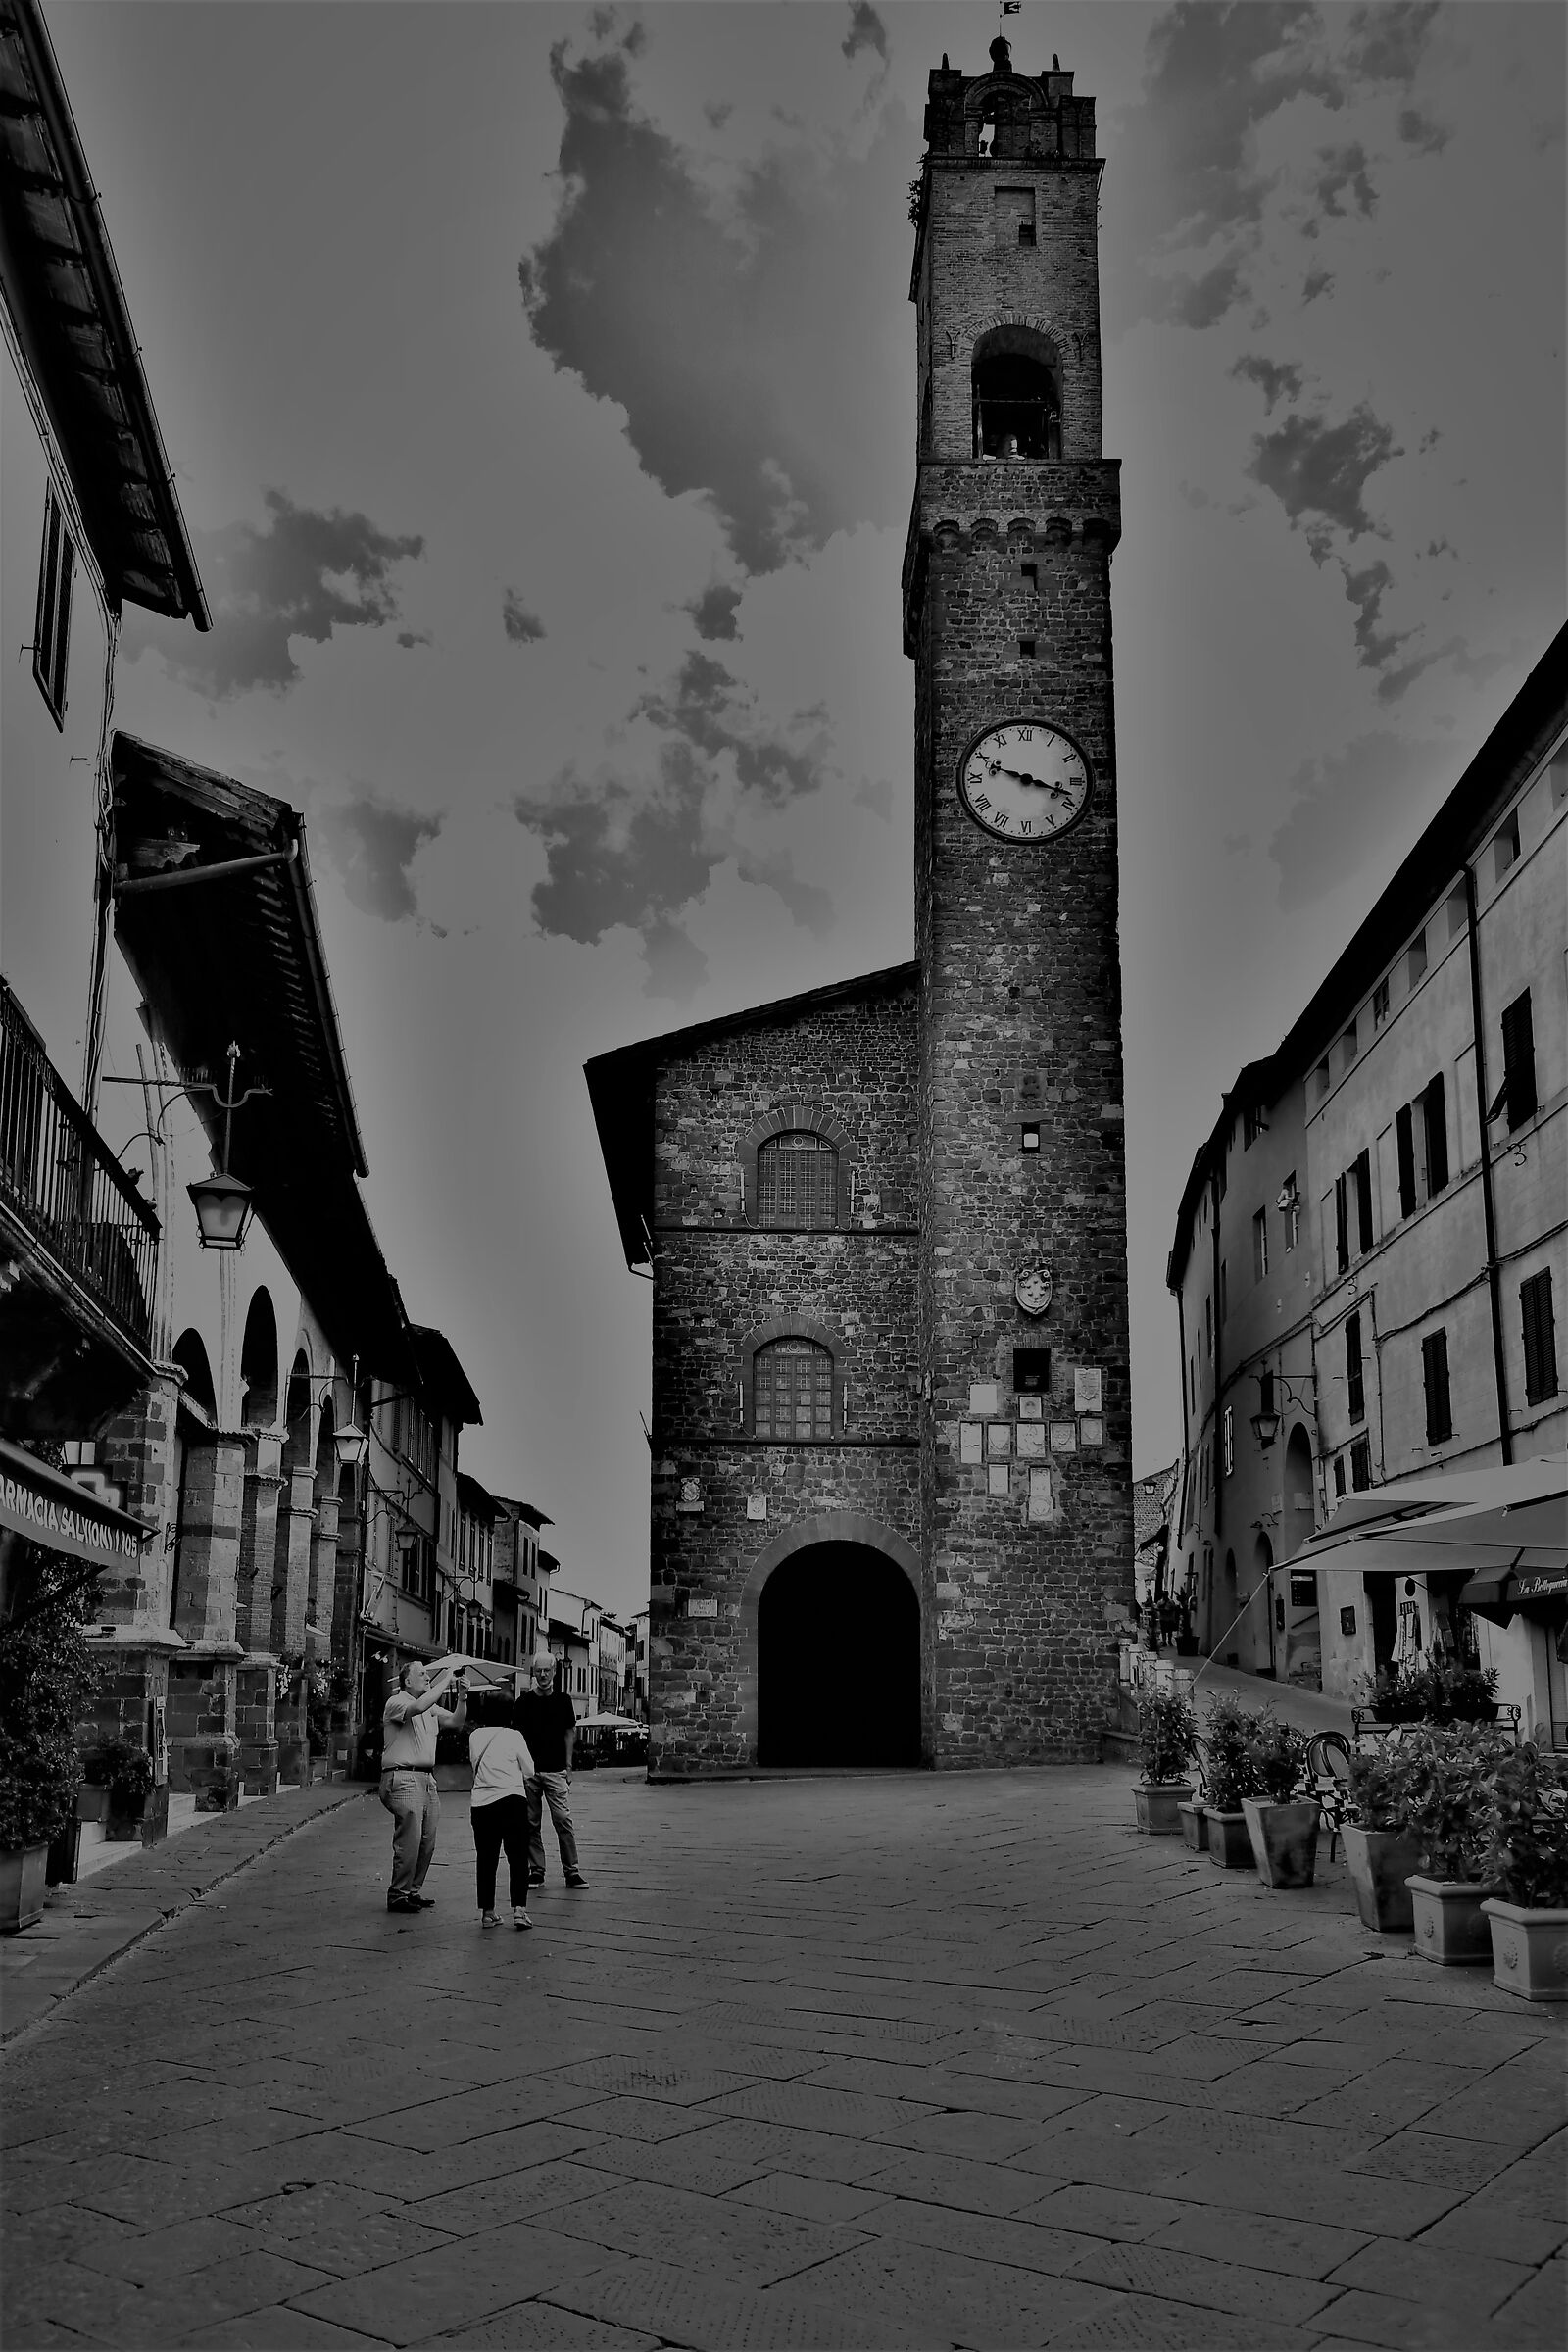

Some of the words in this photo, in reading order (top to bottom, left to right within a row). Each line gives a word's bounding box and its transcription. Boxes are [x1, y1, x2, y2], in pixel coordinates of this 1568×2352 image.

[994, 734, 1007, 748] XI
[1018, 730, 1033, 742] XII
[1047, 735, 1055, 747] I
[1062, 753, 1077, 763] II
[967, 772, 982, 784] IX
[1069, 777, 1083, 786] III
[975, 793, 992, 811] VIII
[1061, 797, 1076, 811] IV
[994, 811, 1009, 828] VII
[1045, 814, 1055, 827] V
[1020, 820, 1032, 833] VI
[60, 1506, 113, 1551] SALVIONI
[115, 1528, 138, 1559] 1905
[1518, 1578, 1530, 1594] La
